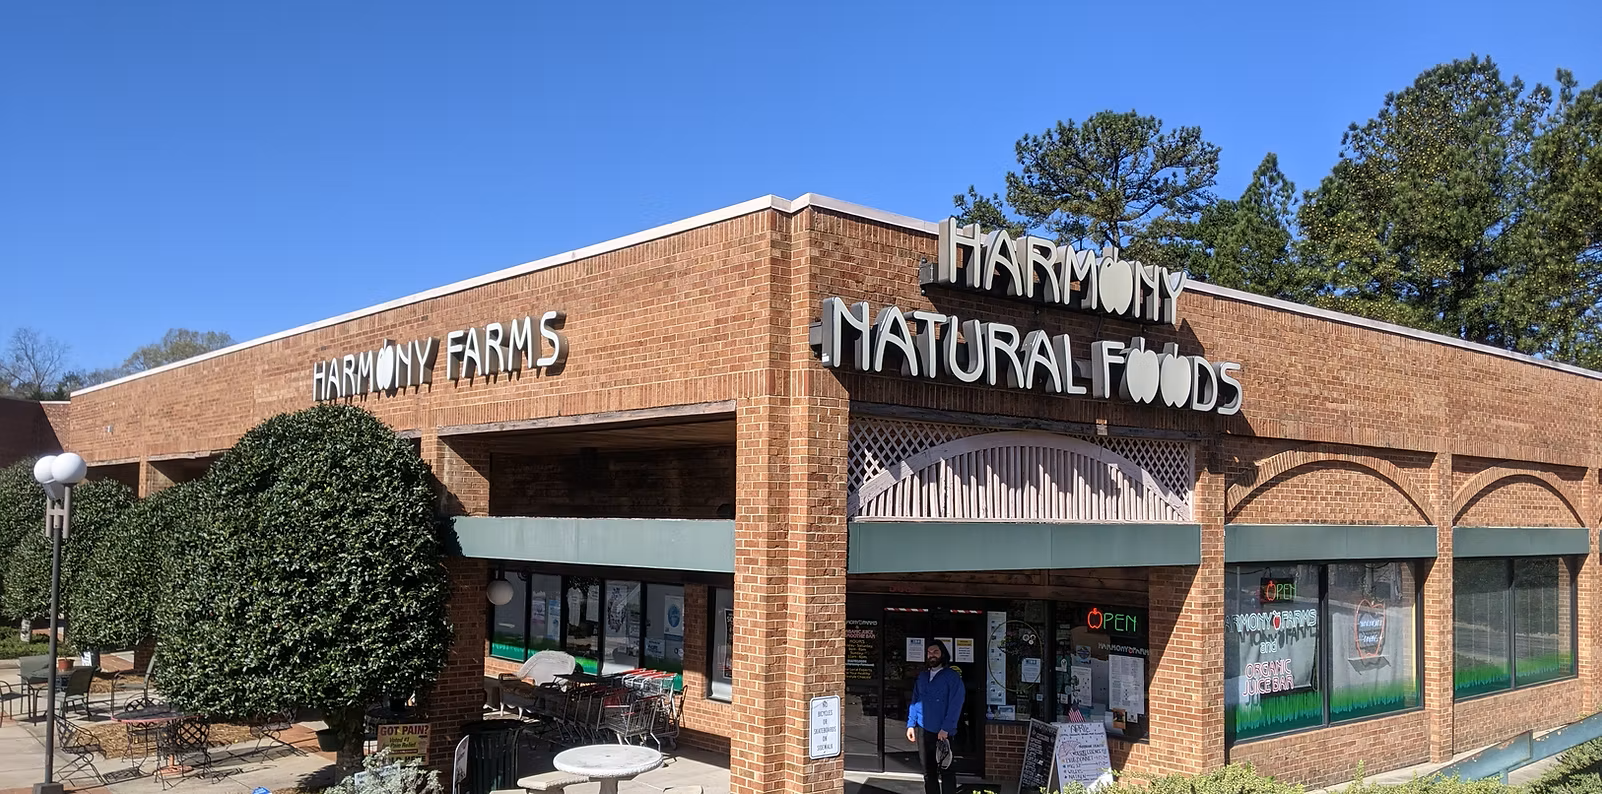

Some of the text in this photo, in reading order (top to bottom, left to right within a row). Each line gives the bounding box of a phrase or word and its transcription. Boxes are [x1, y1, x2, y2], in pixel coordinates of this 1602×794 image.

[945, 216, 1187, 325] HARMONY
[312, 310, 561, 402] HARMONY FARMS
[831, 296, 1244, 416] NATURAL FOODS
[1266, 580, 1297, 601] OPEN
[1087, 607, 1137, 632] OPEN
[1225, 608, 1317, 632] ARMONY FARMS
[1260, 639, 1278, 654] and
[1245, 658, 1292, 680] ORGANIC
[1242, 675, 1295, 697] JUICE BAR
[817, 709, 833, 718] BICYCLES
[380, 724, 430, 736] GOT PAIN?
